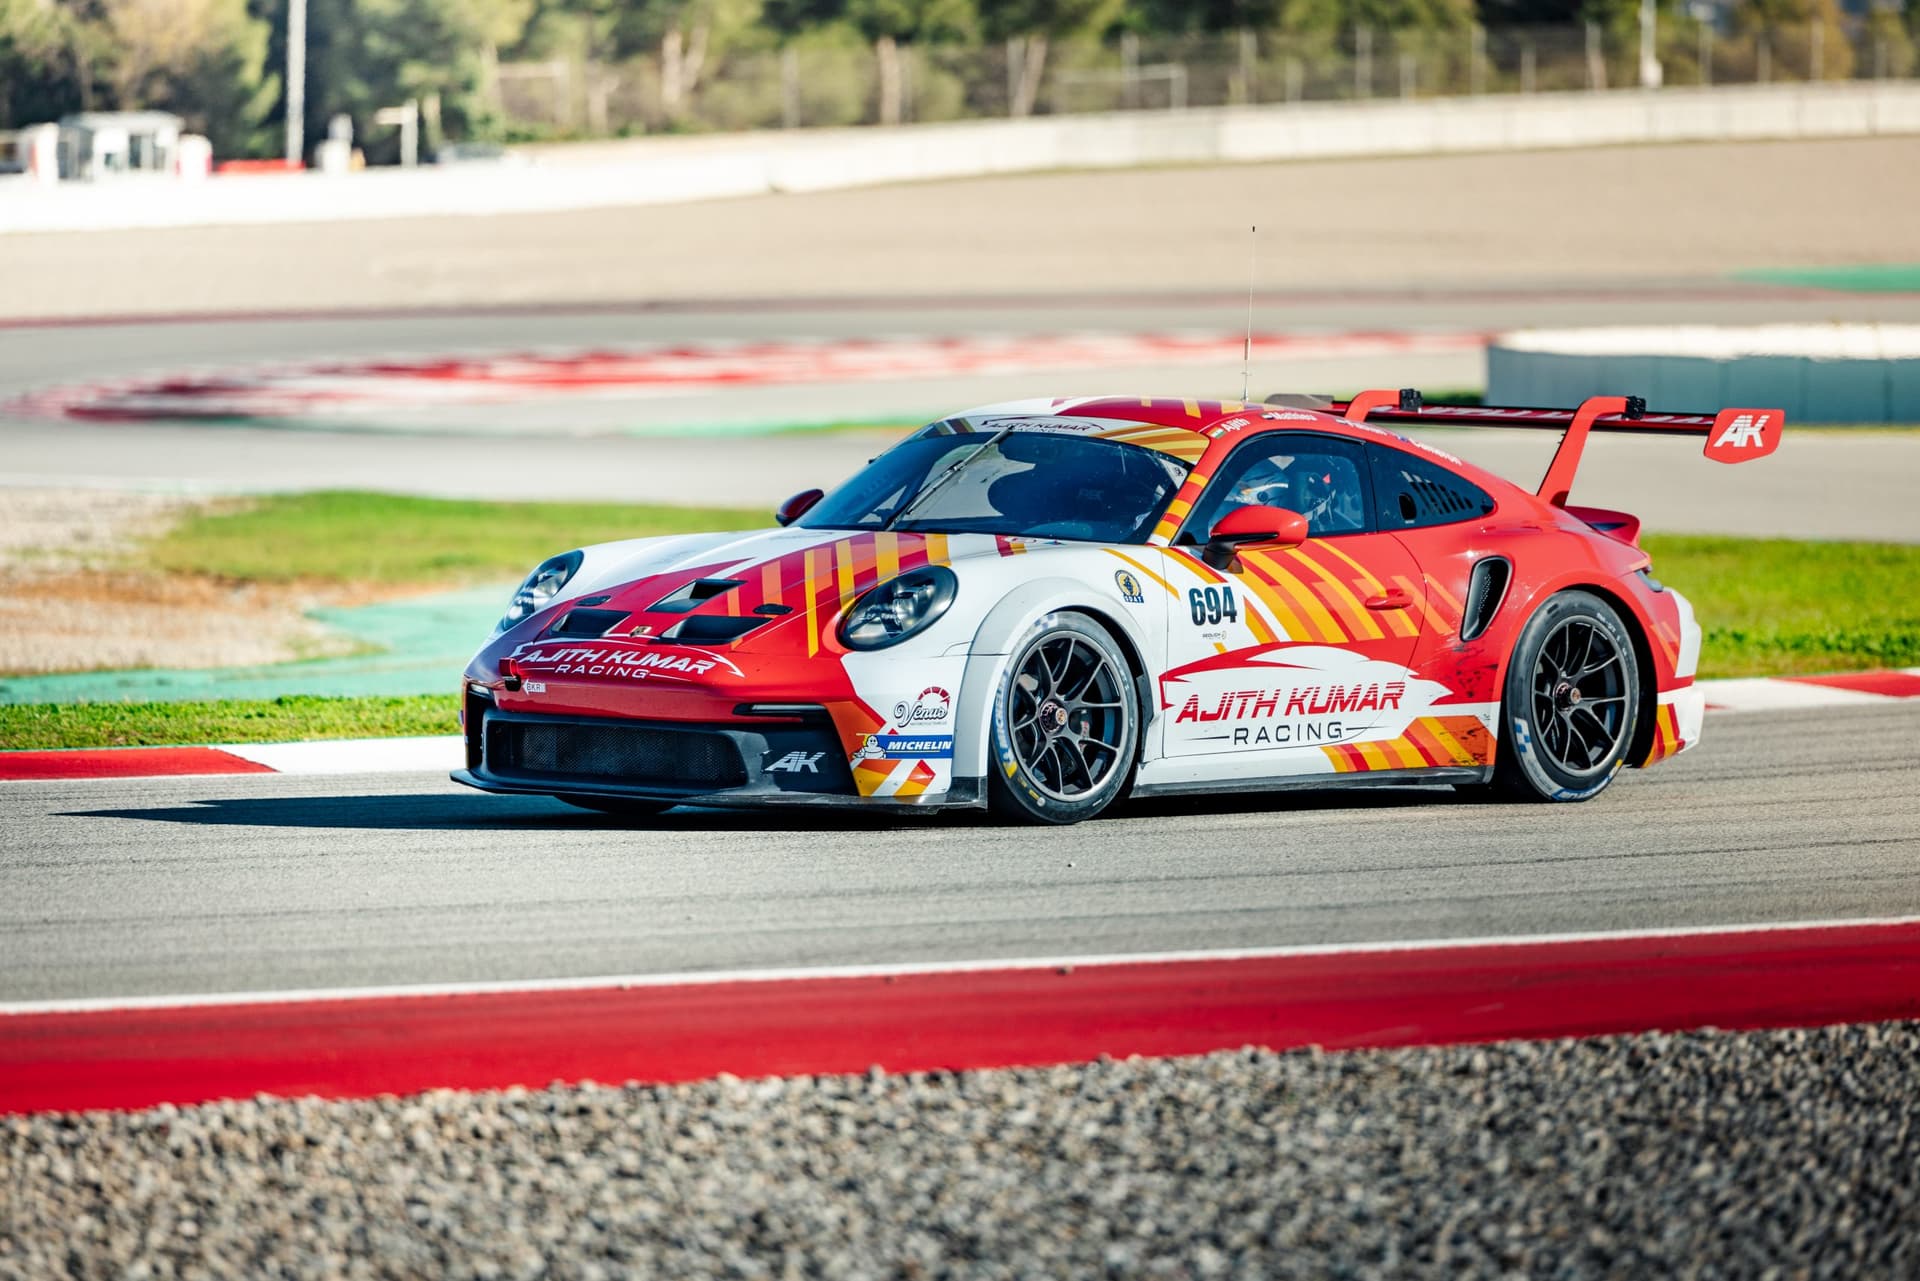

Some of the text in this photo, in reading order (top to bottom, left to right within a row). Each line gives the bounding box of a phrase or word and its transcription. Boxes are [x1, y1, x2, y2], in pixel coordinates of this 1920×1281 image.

[1220, 417, 1251, 432] Ajith
[1713, 414, 1771, 448] AK
[1188, 586, 1238, 626] 694
[518, 648, 717, 675] AJITH KUMAR
[555, 664, 649, 679] RACING
[894, 700, 949, 728] Venus
[1175, 681, 1406, 724] AJITH KUMAR
[887, 740, 952, 750] MICHELIN
[1233, 721, 1343, 746] RACING
[764, 751, 827, 773] AK
